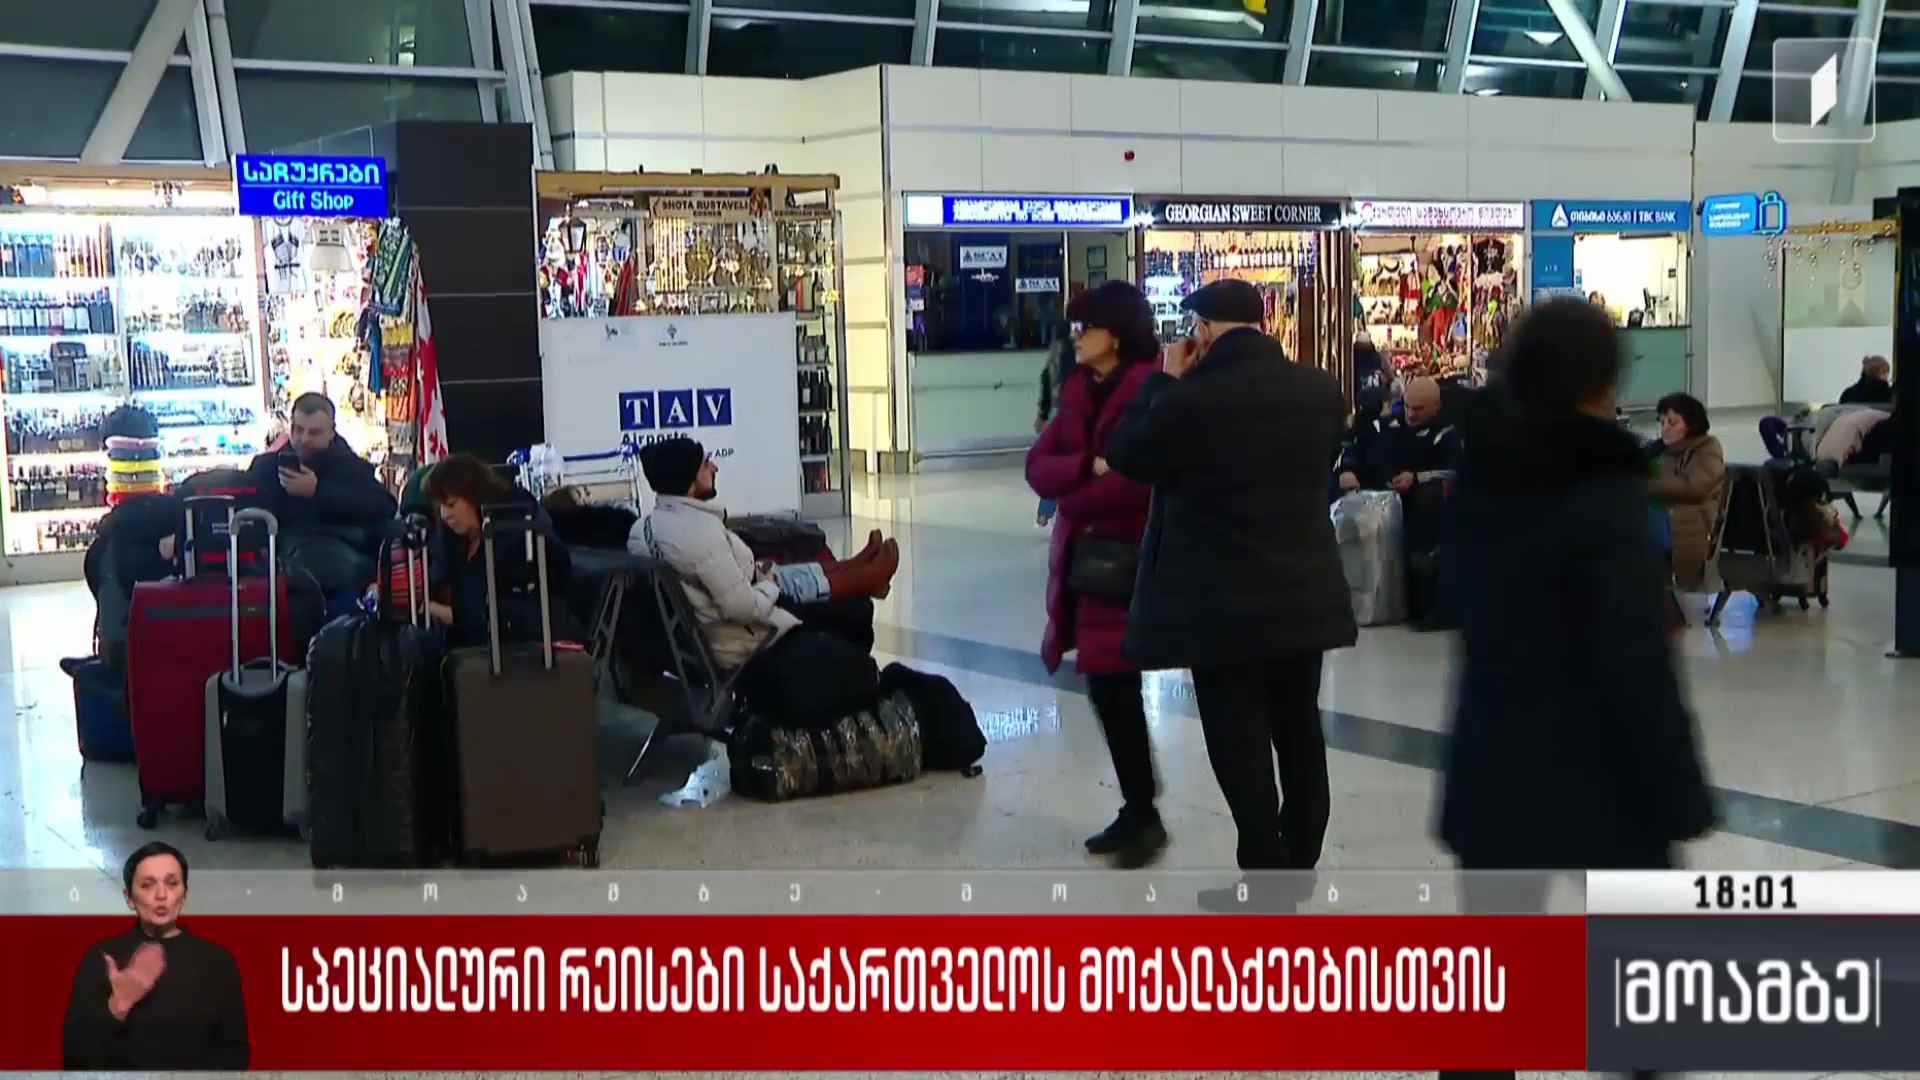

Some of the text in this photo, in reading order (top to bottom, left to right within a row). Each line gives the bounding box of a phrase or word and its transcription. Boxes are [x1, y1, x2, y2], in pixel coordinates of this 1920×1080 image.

[243, 160, 380, 184] საჩუქრები
[273, 190, 354, 210] Gift Shop
[662, 199, 748, 209] SHOTA RUSTAVELI
[1165, 204, 1322, 222] GEORGIAN SWEET CORNER
[1639, 209, 1676, 223] TBC BANK
[622, 392, 728, 427] TAV
[715, 447, 735, 457] ADP
